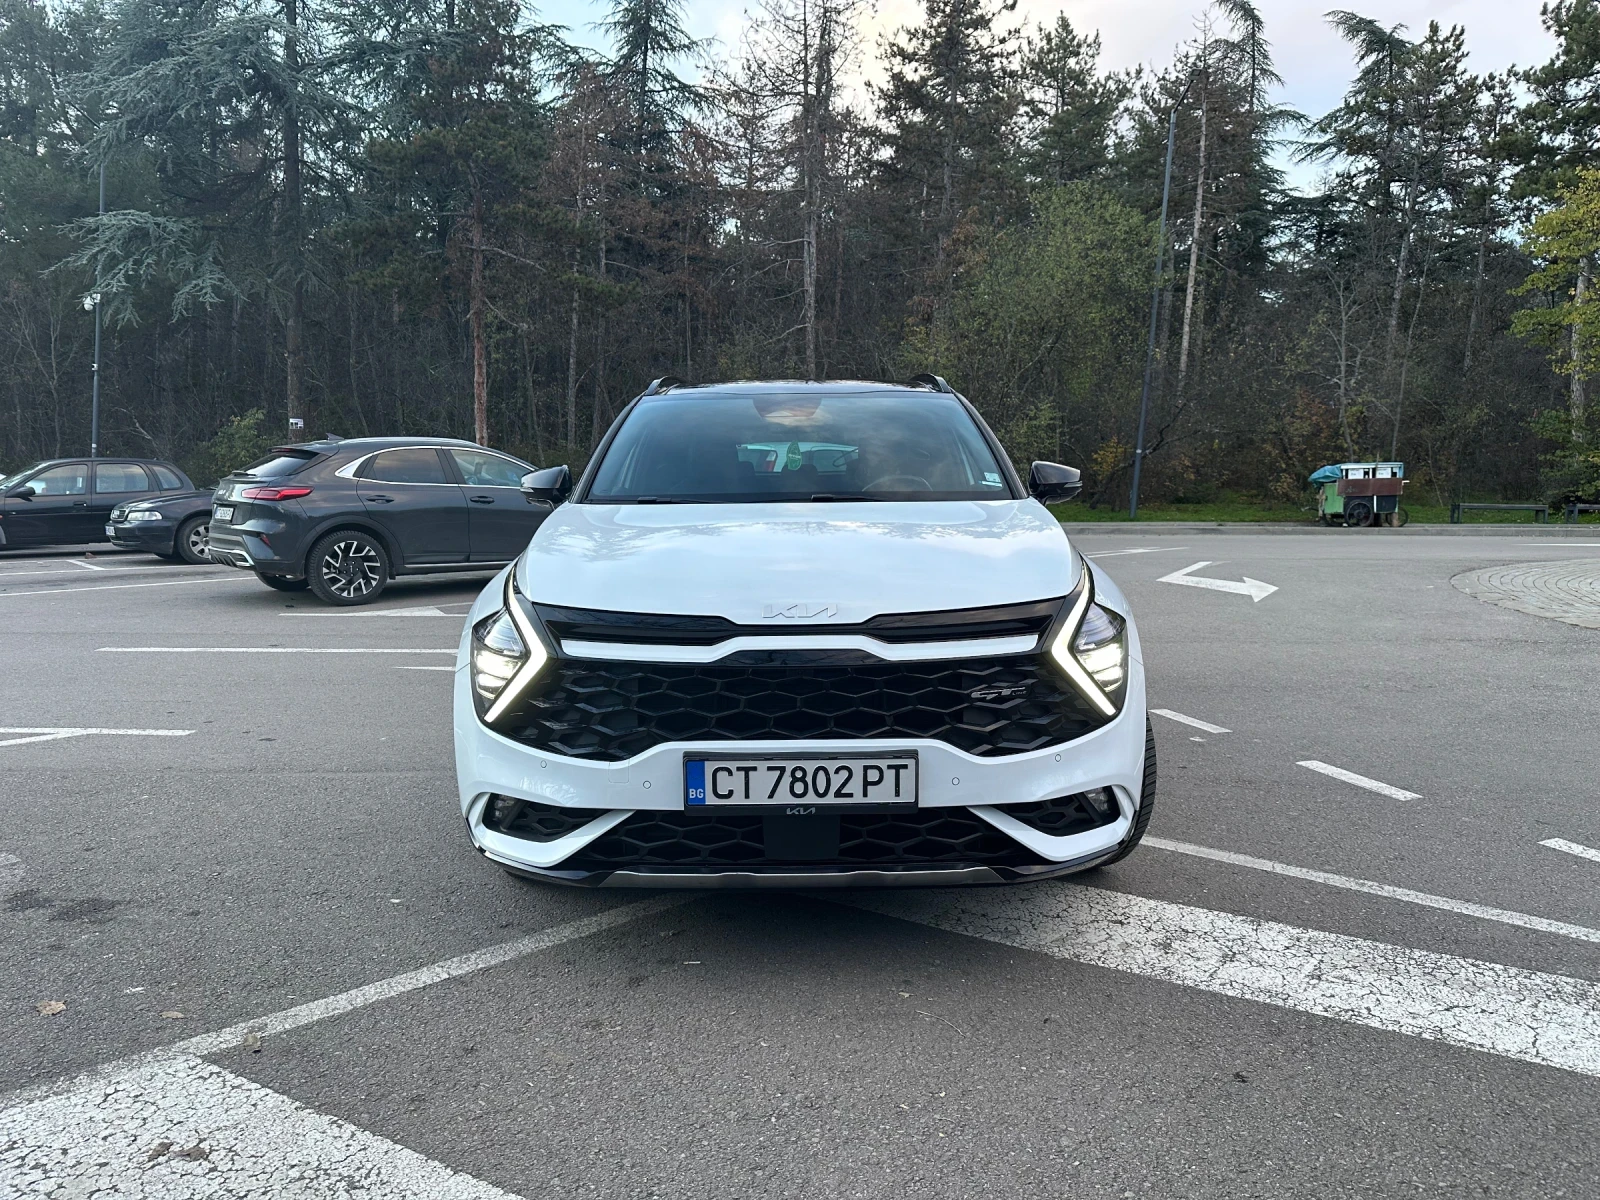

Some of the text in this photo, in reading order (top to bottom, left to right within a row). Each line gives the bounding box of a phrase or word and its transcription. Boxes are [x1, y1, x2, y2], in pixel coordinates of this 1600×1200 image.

[689, 788, 704, 799] BG
[711, 763, 909, 800] CT 7802 PT
